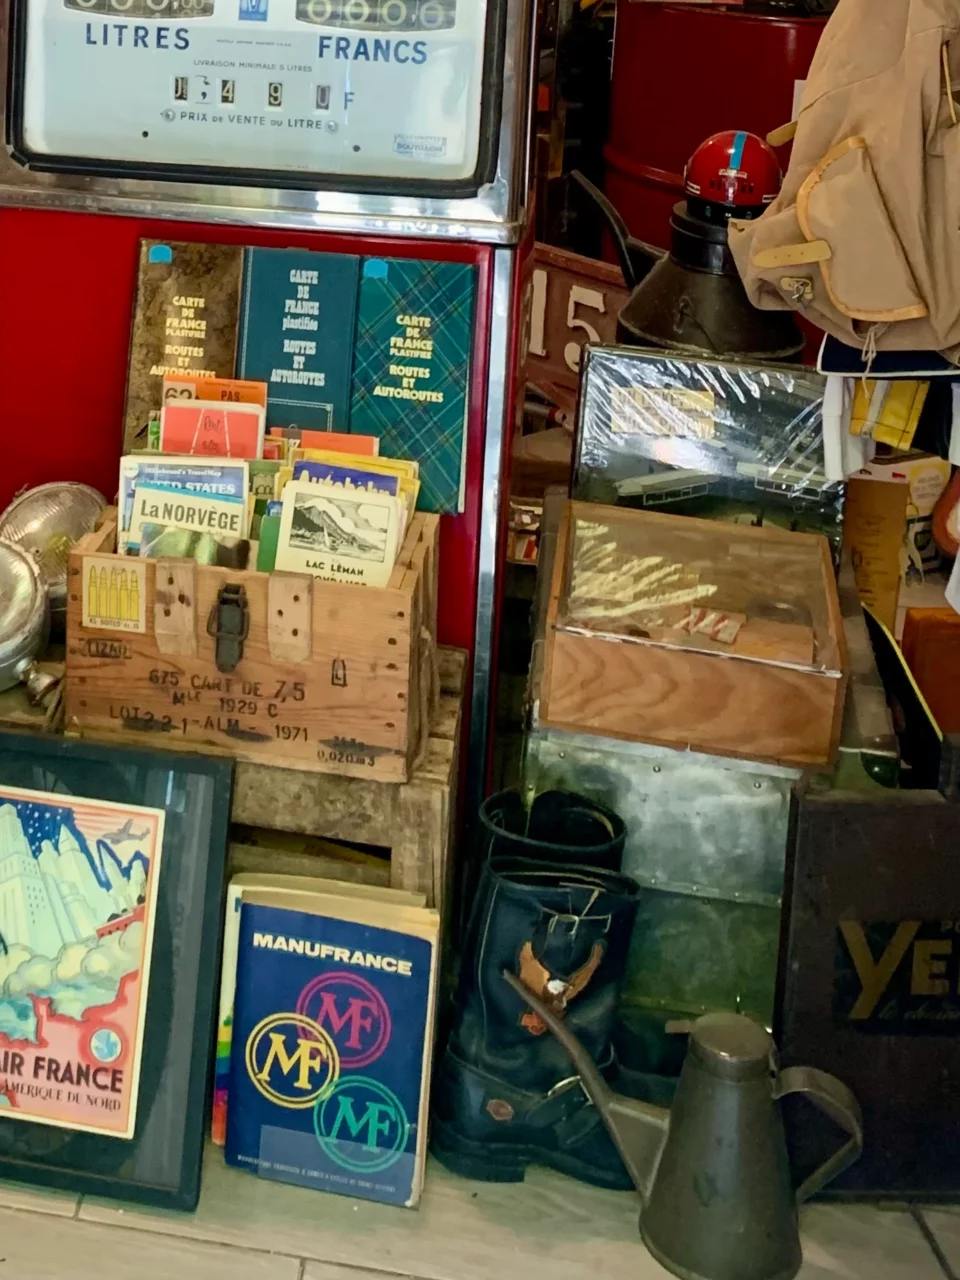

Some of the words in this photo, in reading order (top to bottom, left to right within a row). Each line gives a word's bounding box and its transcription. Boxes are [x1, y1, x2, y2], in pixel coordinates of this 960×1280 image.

[86, 23, 190, 51] LITRES
[318, 35, 428, 65] FRANCS
[193, 60, 235, 68] LIVRAISON
[238, 62, 277, 71] MINIMALE
[287, 65, 312, 73] LITRES
[222, 80, 234, 102] 4
[269, 83, 282, 105] 9
[344, 92, 355, 110] F
[180, 111, 208, 121] PRIX
[228, 115, 266, 125] VENTE
[288, 119, 322, 130] LITRE
[290, 270, 318, 285] CARTE
[297, 285, 310, 299] DE
[172, 296, 205, 308] CARTE
[285, 299, 320, 315] FRANCE
[181, 308, 194, 318] DE
[166, 318, 207, 330] FRANCE
[396, 315, 431, 328] CARTE
[406, 327, 421, 338] DE
[165, 345, 204, 358] ROUTES
[283, 339, 317, 355] ROUTES
[390, 337, 433, 351] FRANCE
[177, 357, 190, 367] ET
[293, 355, 306, 370] ET
[270, 369, 326, 387] AUTOROUTES
[389, 365, 430, 379] ROUTES
[402, 377, 415, 389] ET
[373, 385, 444, 403] AUTOROUTES
[185, 481, 236, 495] STATES
[140, 499, 159, 519] La
[162, 503, 240, 532] NORVÈGE
[306, 559, 325, 570] LAC
[149, 669, 180, 687] 675
[191, 674, 233, 693] CART
[242, 681, 263, 697] DE
[274, 680, 305, 703] 7,5
[219, 697, 258, 716] 1929
[268, 703, 278, 718] C
[275, 724, 308, 742] 1971
[253, 932, 412, 976] MANUFRANCE
[838, 919, 960, 1021] YE
[314, 991, 379, 1049] MF
[257, 1032, 327, 1090] MF
[33, 1055, 123, 1094] FRANCE
[86, 1095, 122, 1112] NORD
[324, 1095, 395, 1153] MF
